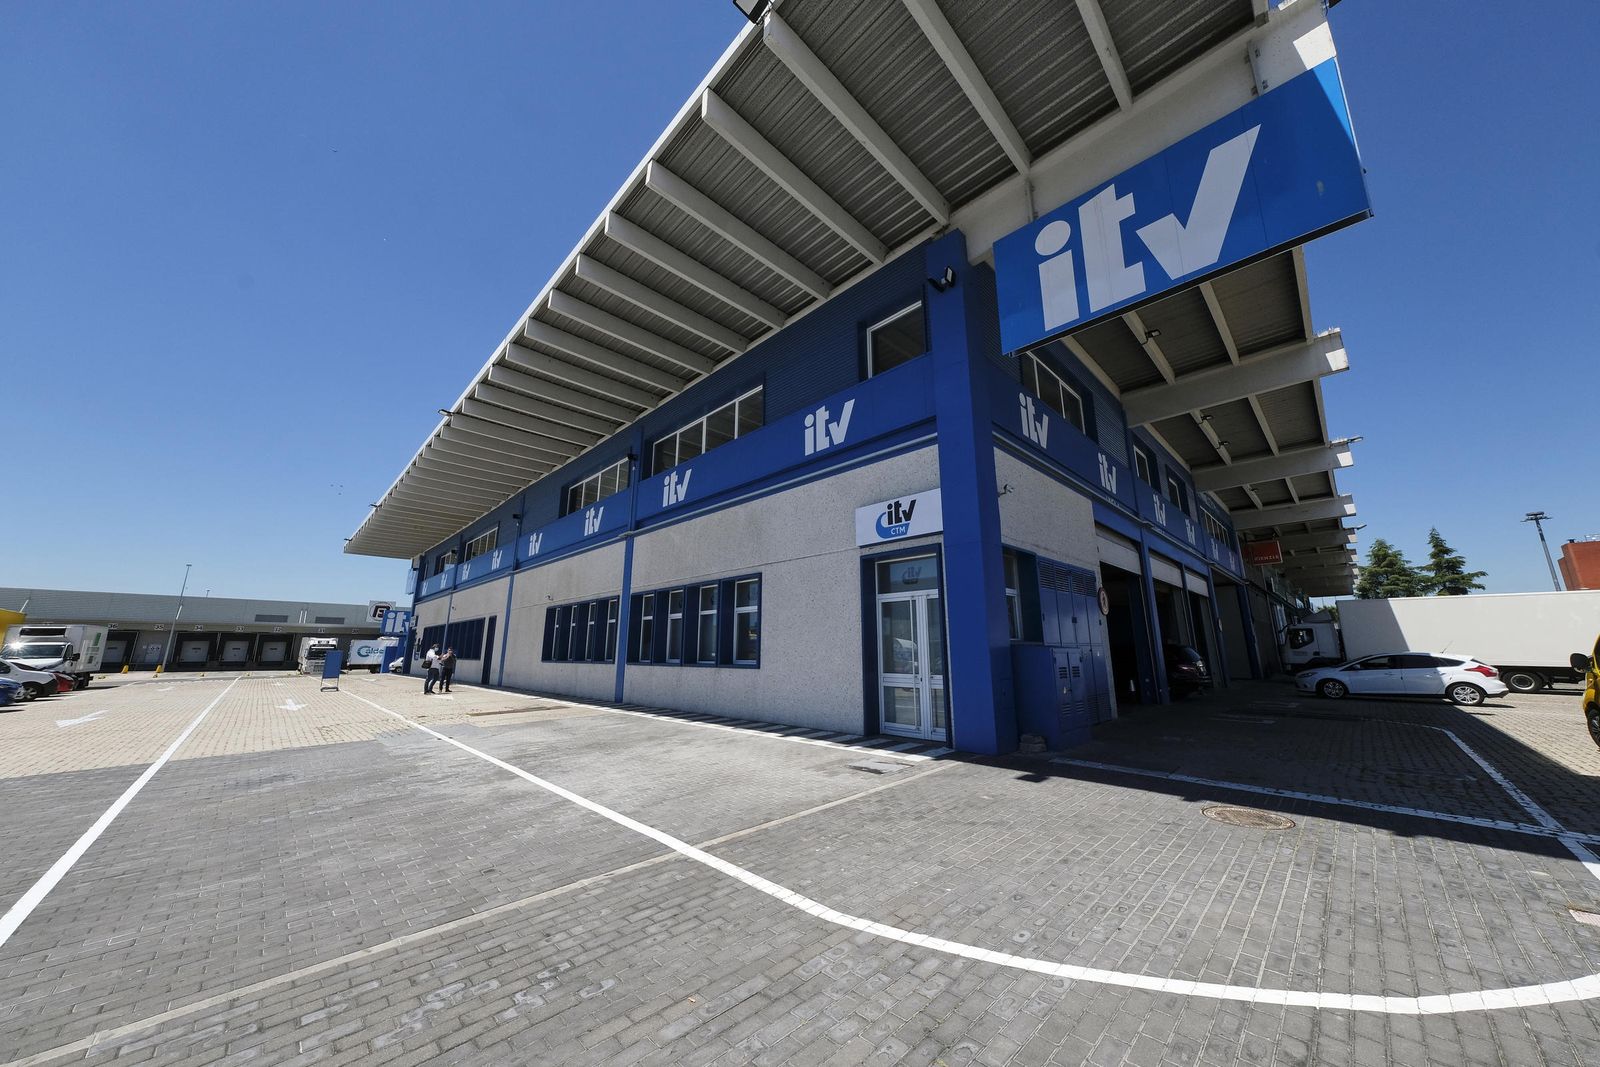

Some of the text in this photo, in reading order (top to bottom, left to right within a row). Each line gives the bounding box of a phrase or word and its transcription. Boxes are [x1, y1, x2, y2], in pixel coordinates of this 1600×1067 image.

[1035, 123, 1262, 331] itv
[804, 398, 856, 456] itv
[1018, 392, 1049, 449] itv
[662, 468, 692, 507] itv
[1097, 452, 1117, 495] itv
[584, 506, 604, 536] itv
[886, 499, 917, 526] itv
[1152, 493, 1166, 527] itv
[528, 532, 543, 557] itv
[890, 527, 906, 535] CTM
[491, 549, 503, 571] itv
